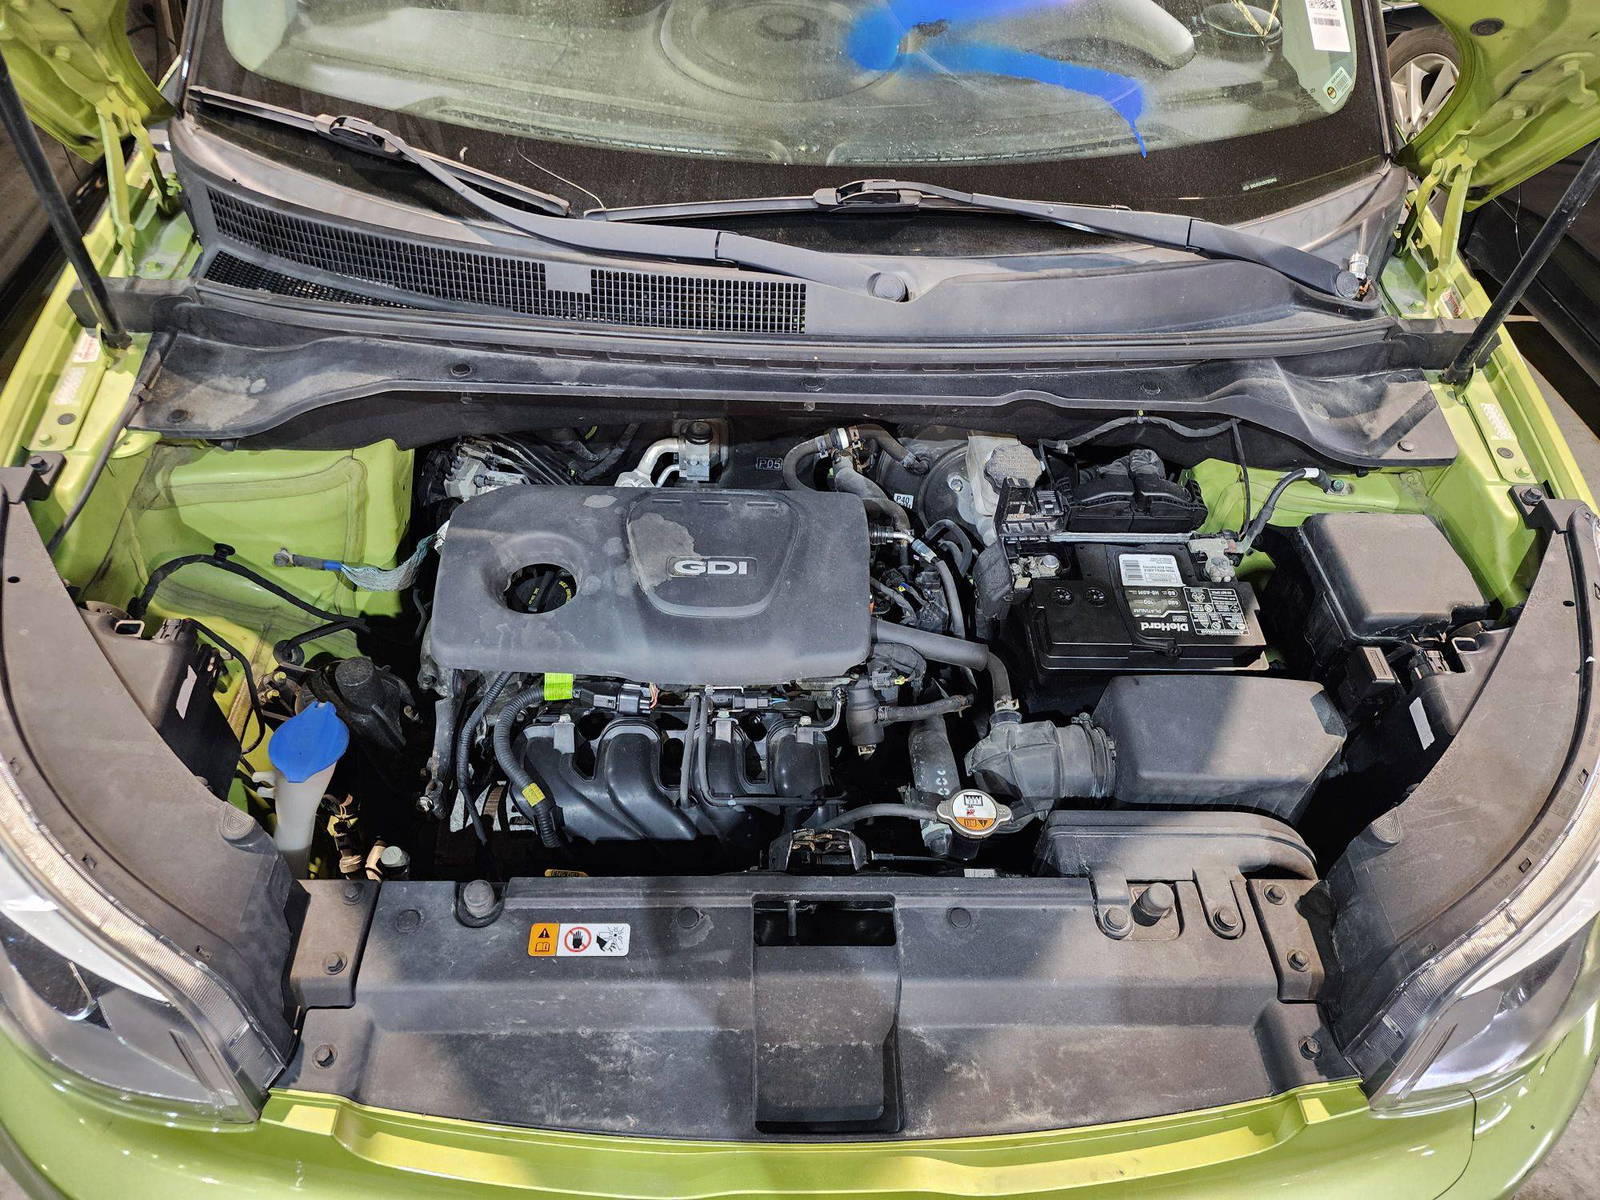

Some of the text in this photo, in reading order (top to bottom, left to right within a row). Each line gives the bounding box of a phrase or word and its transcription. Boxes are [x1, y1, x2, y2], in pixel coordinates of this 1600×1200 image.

[896, 495, 910, 505] P40
[673, 559, 748, 576] GDI
[1141, 622, 1189, 632] DieHard
